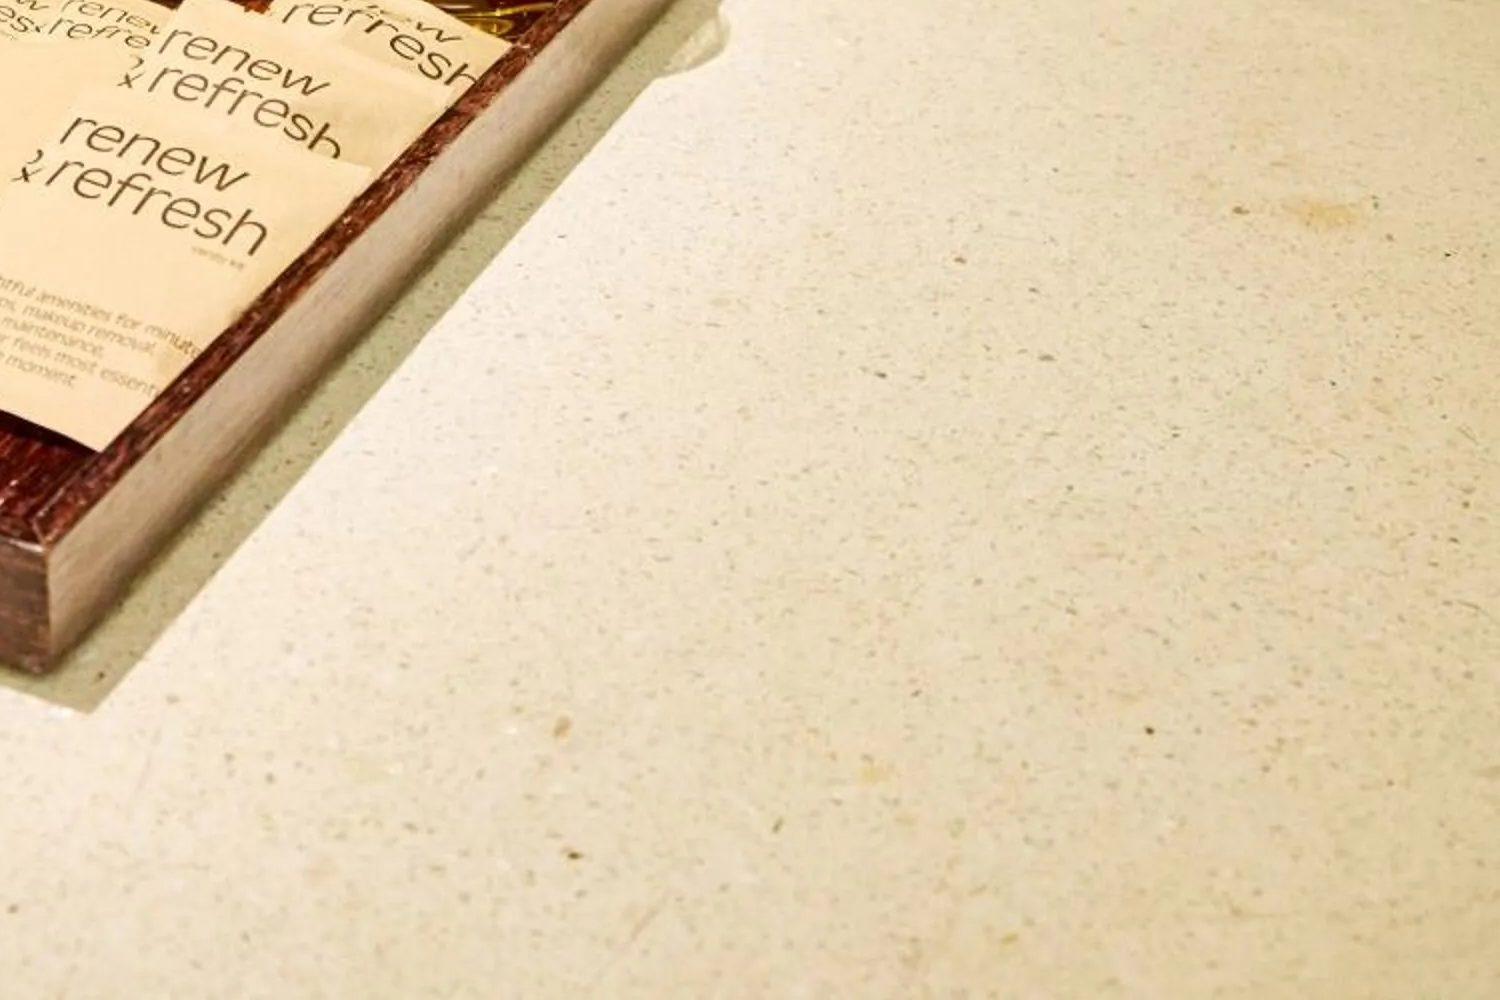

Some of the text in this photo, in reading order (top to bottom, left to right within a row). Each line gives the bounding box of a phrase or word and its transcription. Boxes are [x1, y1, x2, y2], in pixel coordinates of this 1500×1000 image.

[158, 27, 331, 96] renew
[282, 2, 479, 87] refresh
[148, 65, 341, 159] refresh
[60, 117, 250, 192] renew
[45, 161, 267, 256] refresh
[21, 304, 86, 332] makeup
[36, 290, 113, 323] amenities
[115, 312, 143, 329] for
[54, 350, 98, 374] most
